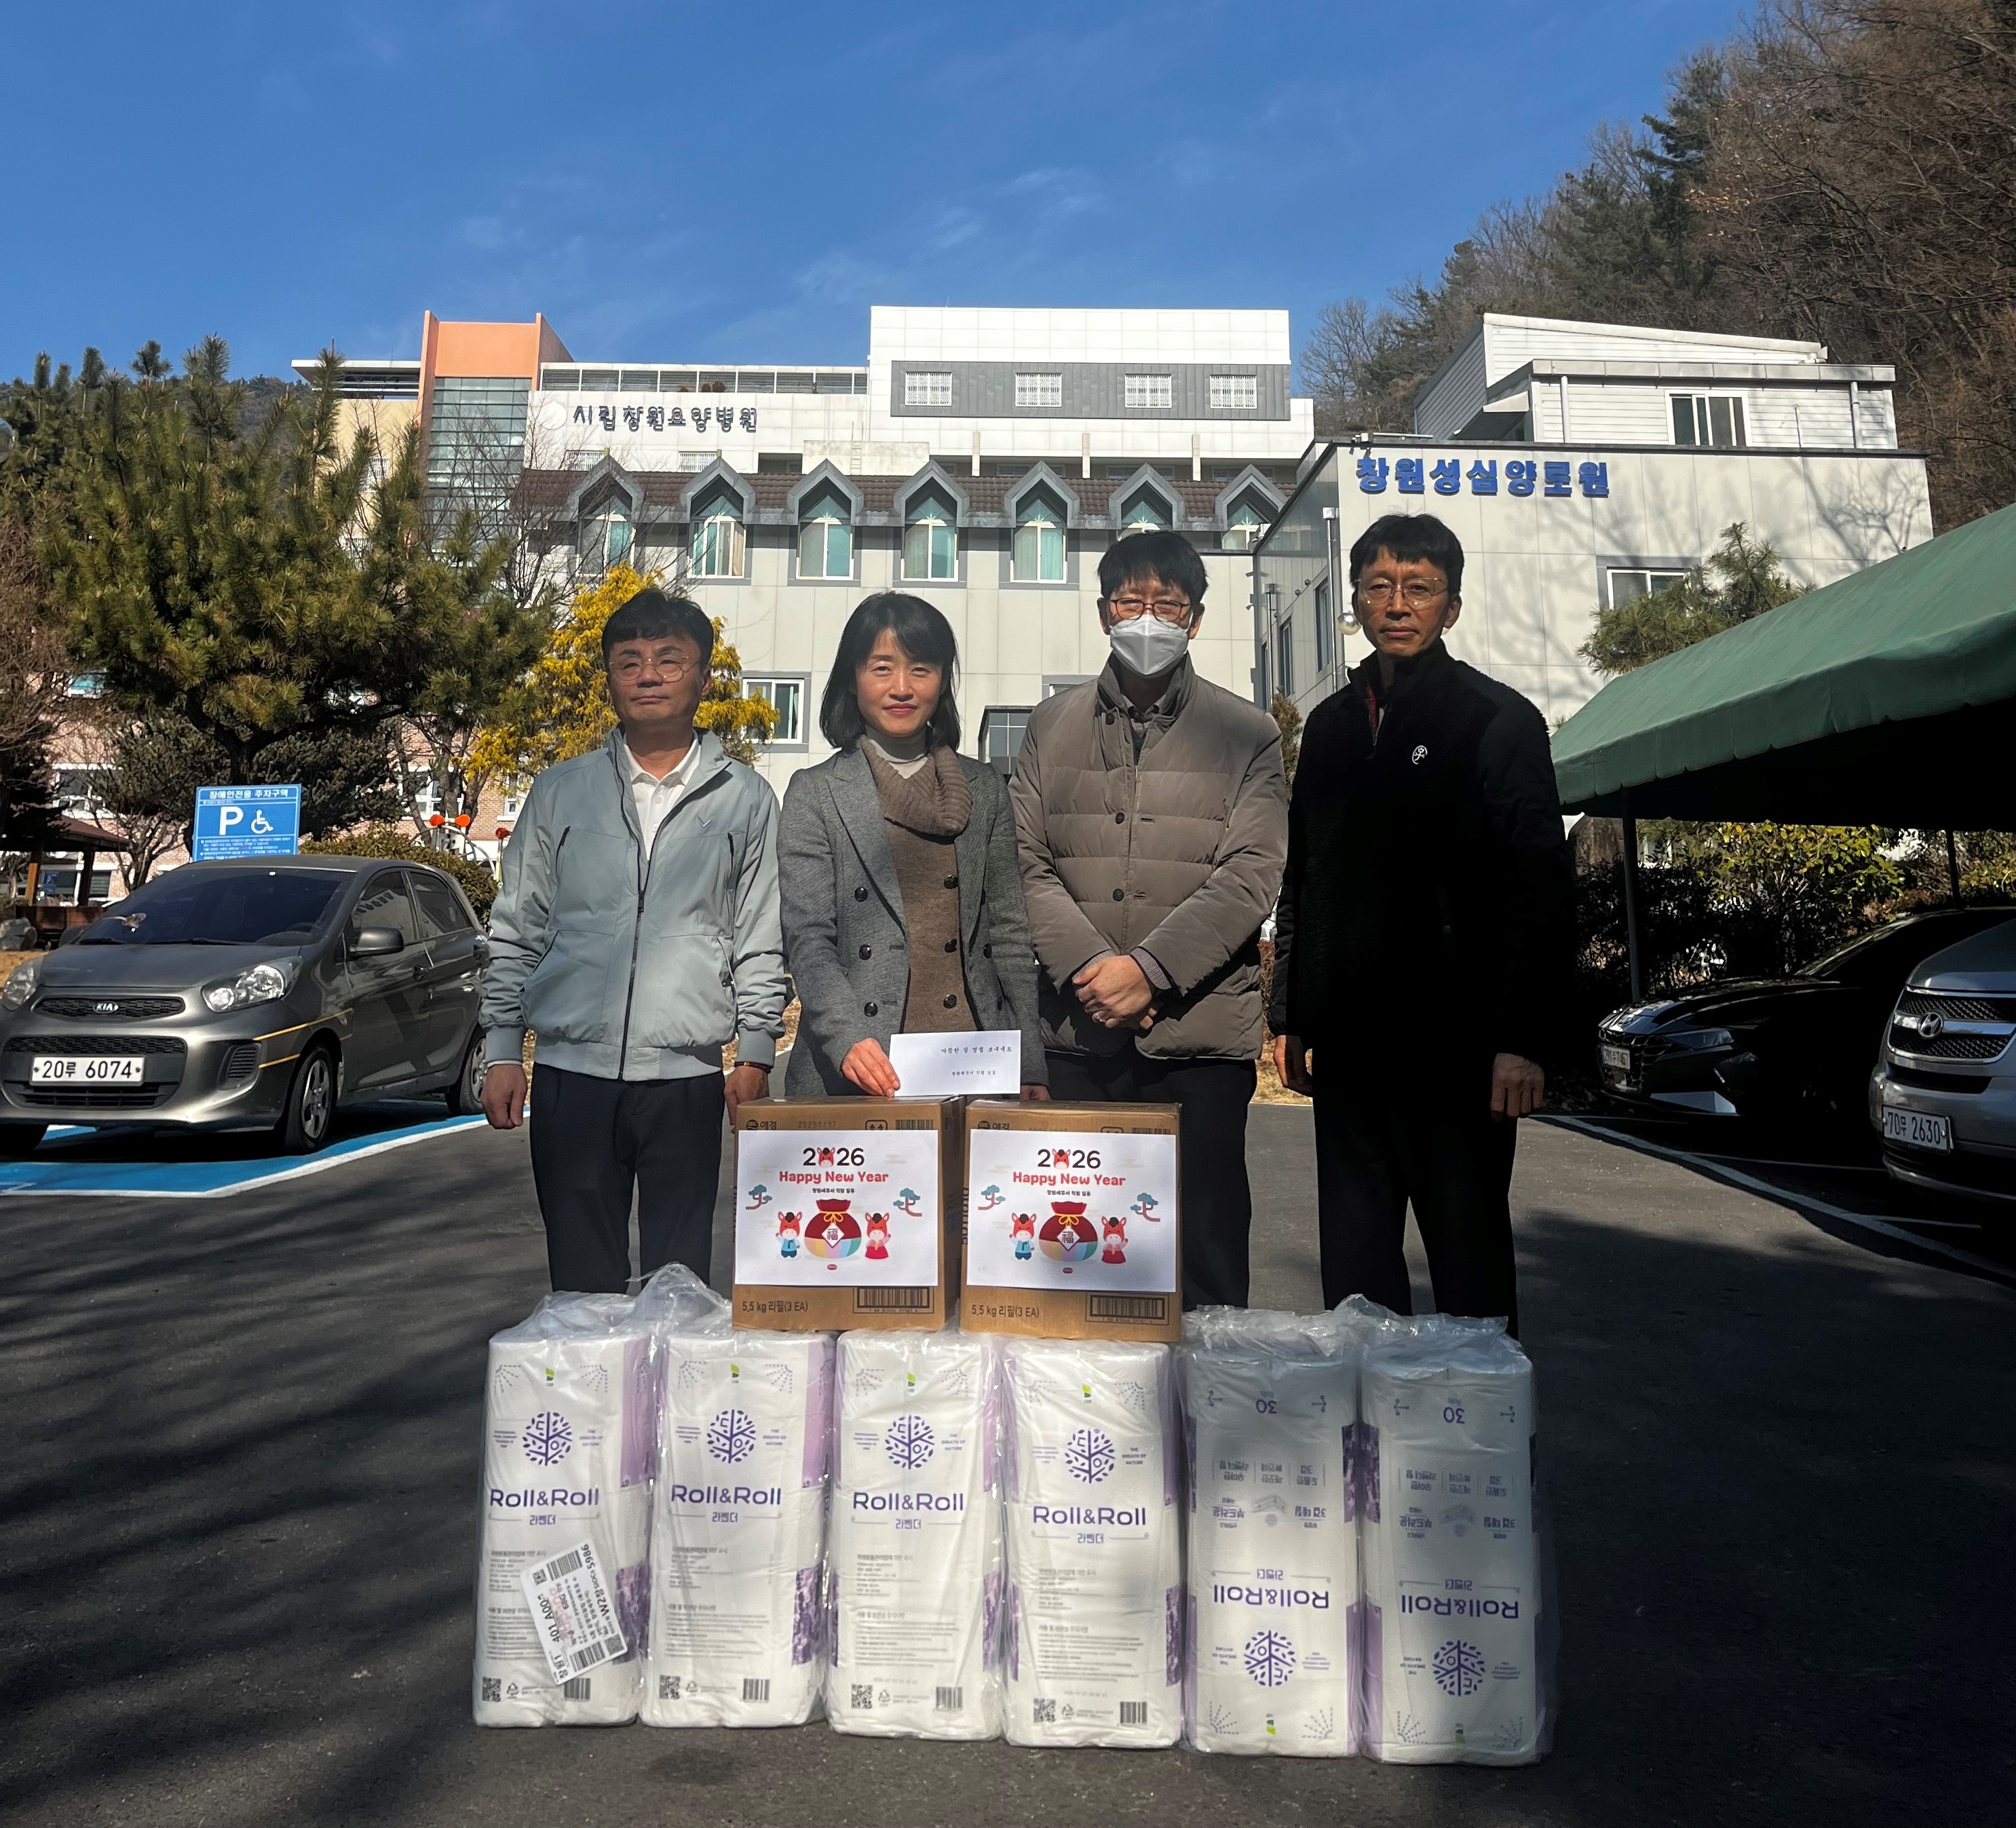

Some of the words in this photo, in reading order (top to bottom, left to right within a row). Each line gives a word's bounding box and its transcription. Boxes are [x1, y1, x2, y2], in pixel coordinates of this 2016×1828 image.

[573, 406, 757, 433] 시립창원요양병원
[1356, 457, 1610, 497] 창원성심양로원
[210, 790, 252, 799] 장애인전용
[254, 789, 288, 797] 주차구역
[219, 806, 244, 835] P
[96, 1003, 113, 1011] KIA
[42, 1061, 76, 1078] 20루
[85, 1061, 132, 1078] 6074
[760, 1120, 777, 1130] 애경
[1888, 1111, 1907, 1137] 70무
[1912, 1116, 1941, 1145] 2630
[803, 1147, 864, 1167] 226
[1037, 1148, 1101, 1168] 226
[779, 1171, 821, 1184] Happy
[825, 1171, 854, 1182] New
[858, 1171, 889, 1182] Year
[1012, 1172, 1057, 1185] Happy
[1061, 1173, 1090, 1185] New
[1094, 1174, 1126, 1186] Year
[826, 1228, 838, 1240] 福
[1061, 1231, 1074, 1244] 福
[742, 1301, 755, 1312] 5.5
[757, 1301, 767, 1313] kg
[972, 1304, 984, 1316] 5.5
[987, 1305, 997, 1317] kg
[1255, 1399, 1278, 1414] 30
[1443, 1407, 1465, 1424] 30
[490, 1488, 599, 1507] Roll&Roll
[670, 1485, 782, 1505] Roll&Roll
[853, 1491, 964, 1511] Roll&Roll
[1033, 1506, 1146, 1525] Roll&Roll
[1213, 1506, 1244, 1519] 부드러운
[581, 1544, 596, 1569] 5986
[1214, 1584, 1329, 1609] Roll&Roll
[1401, 1595, 1519, 1619] Roll&Roll
[548, 1624, 560, 1643] 401
